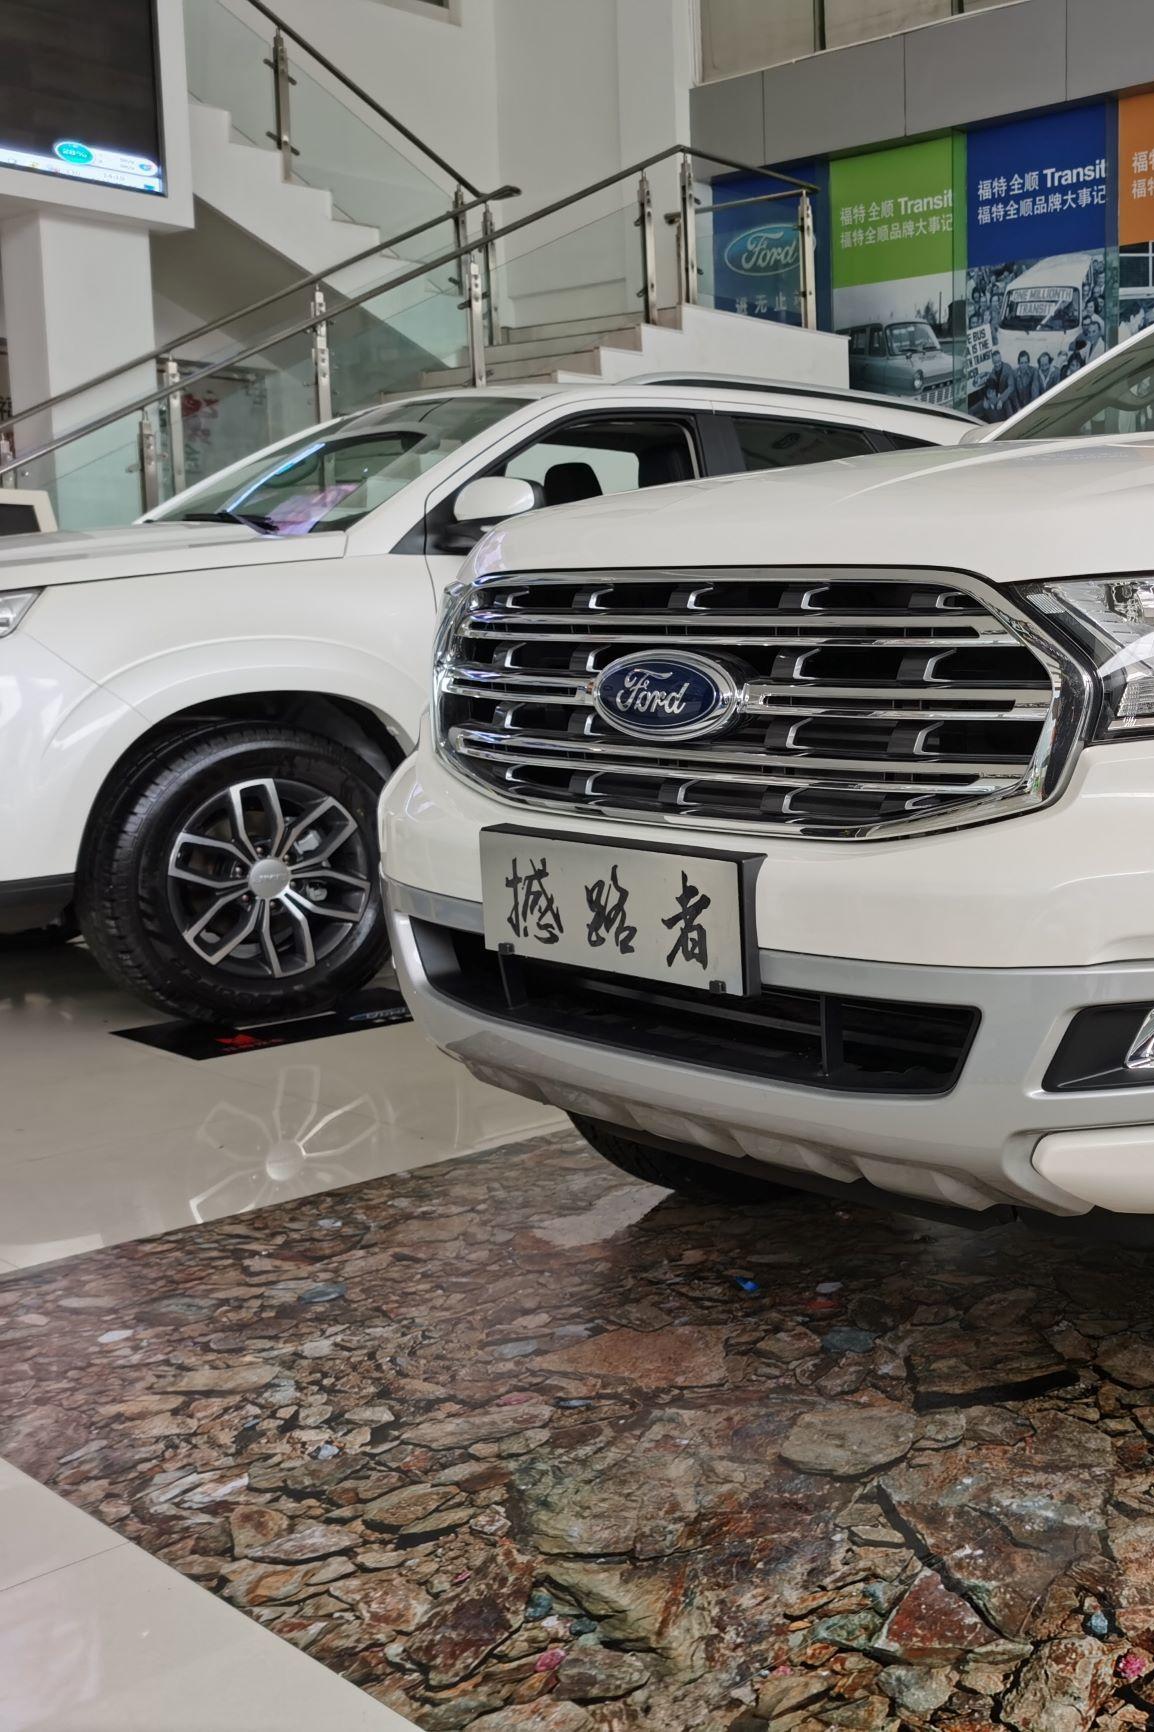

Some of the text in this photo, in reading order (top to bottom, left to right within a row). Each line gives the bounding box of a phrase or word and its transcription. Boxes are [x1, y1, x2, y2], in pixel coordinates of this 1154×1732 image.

[1042, 158, 1107, 189] Transit
[898, 188, 954, 217] Transit
[977, 184, 1107, 226] 福特全顺品牌大事记
[741, 231, 800, 270] Ford
[840, 213, 954, 250] 福特全顺品牌大事记
[973, 328, 987, 343] BUS
[615, 667, 691, 715] Ford
[505, 856, 712, 971] 撼路者
